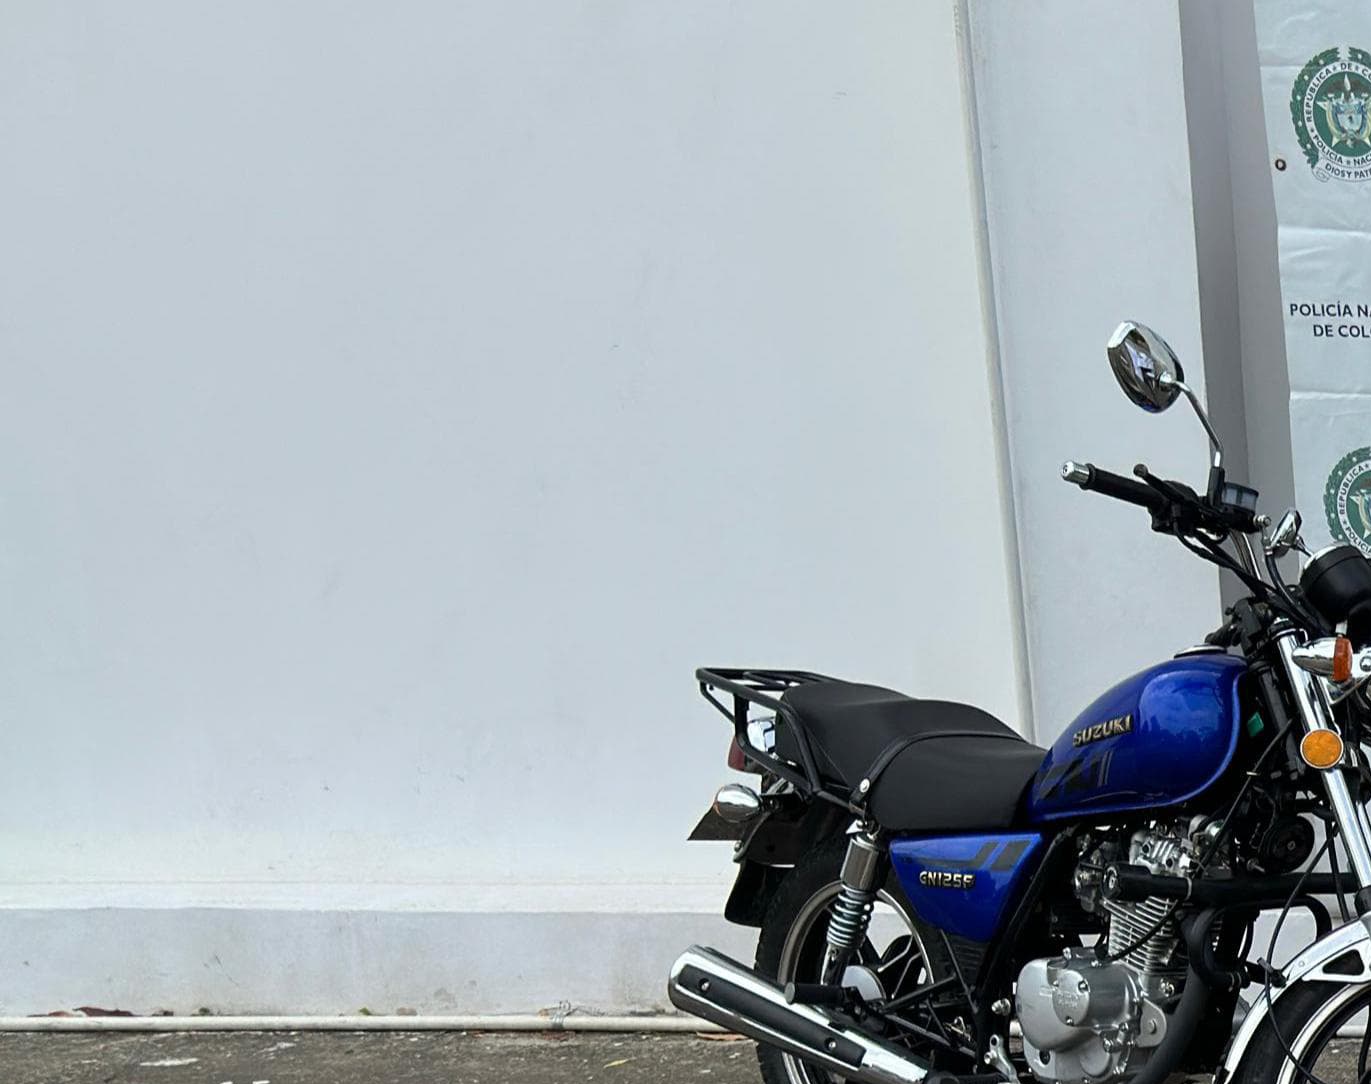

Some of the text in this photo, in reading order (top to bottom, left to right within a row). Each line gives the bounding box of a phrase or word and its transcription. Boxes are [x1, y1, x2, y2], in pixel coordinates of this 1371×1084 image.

[1290, 301, 1353, 317] POLICÍA
[1313, 325, 1334, 337] DE
[1072, 715, 1131, 747] SUZUKI
